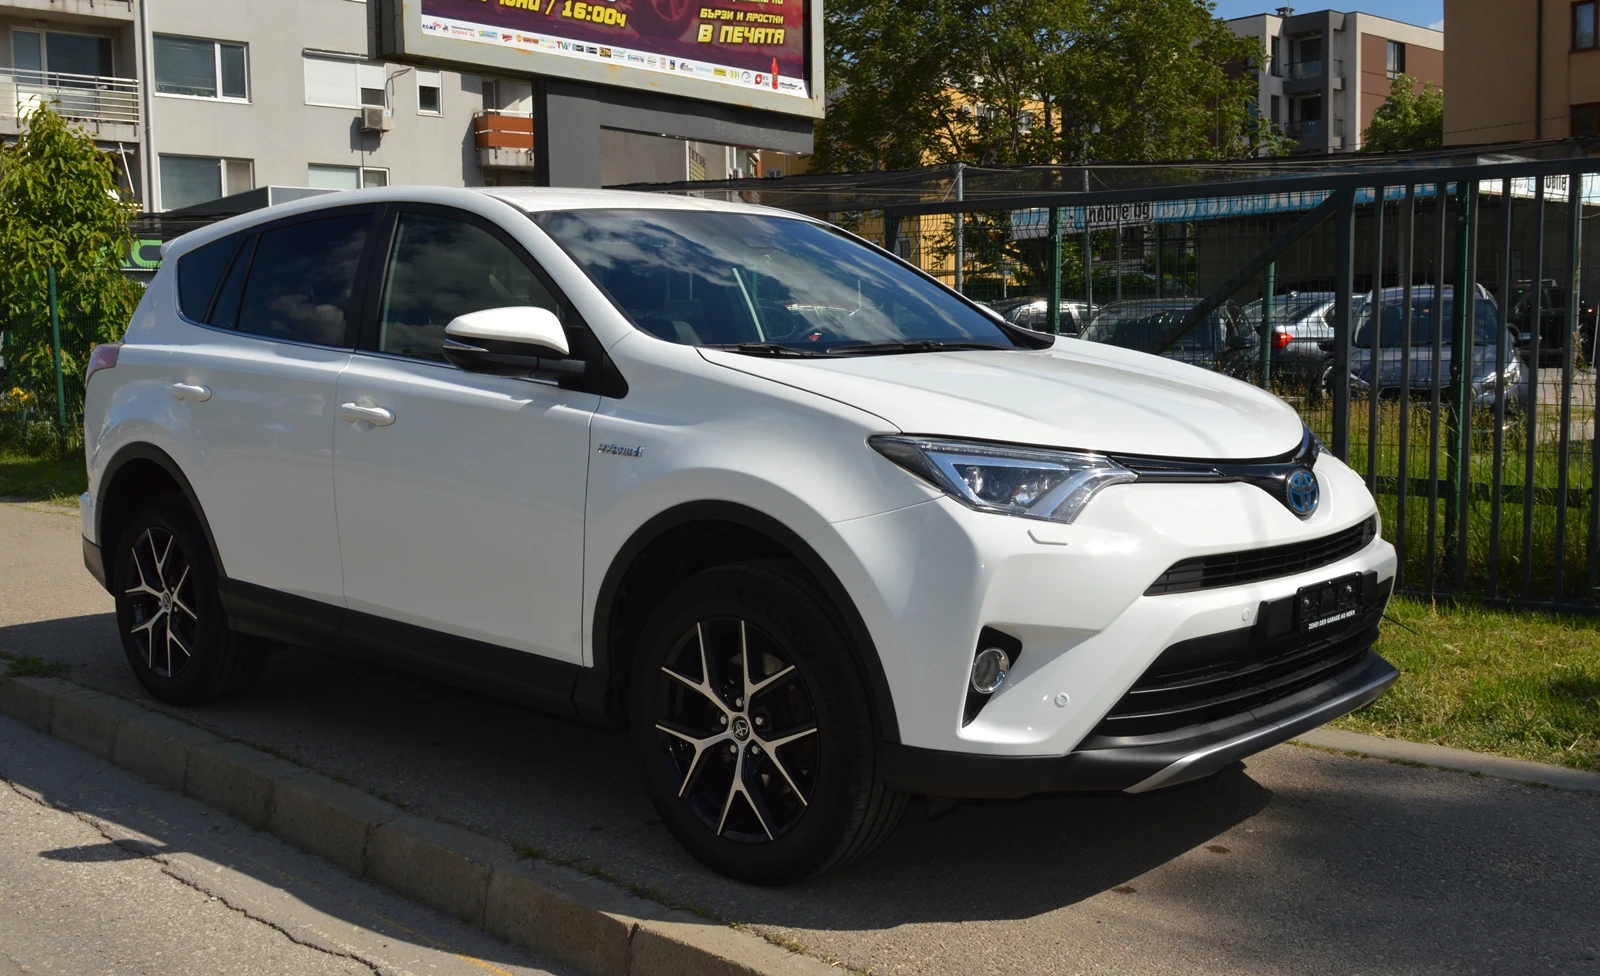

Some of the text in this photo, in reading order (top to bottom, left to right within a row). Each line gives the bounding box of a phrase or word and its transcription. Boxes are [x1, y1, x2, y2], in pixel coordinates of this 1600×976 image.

[562, 1, 627, 27] 16:00ч
[700, 8, 784, 24] БЪРЗИ И ЯРОСТНИ
[697, 24, 785, 44] В ПЕЧАТА
